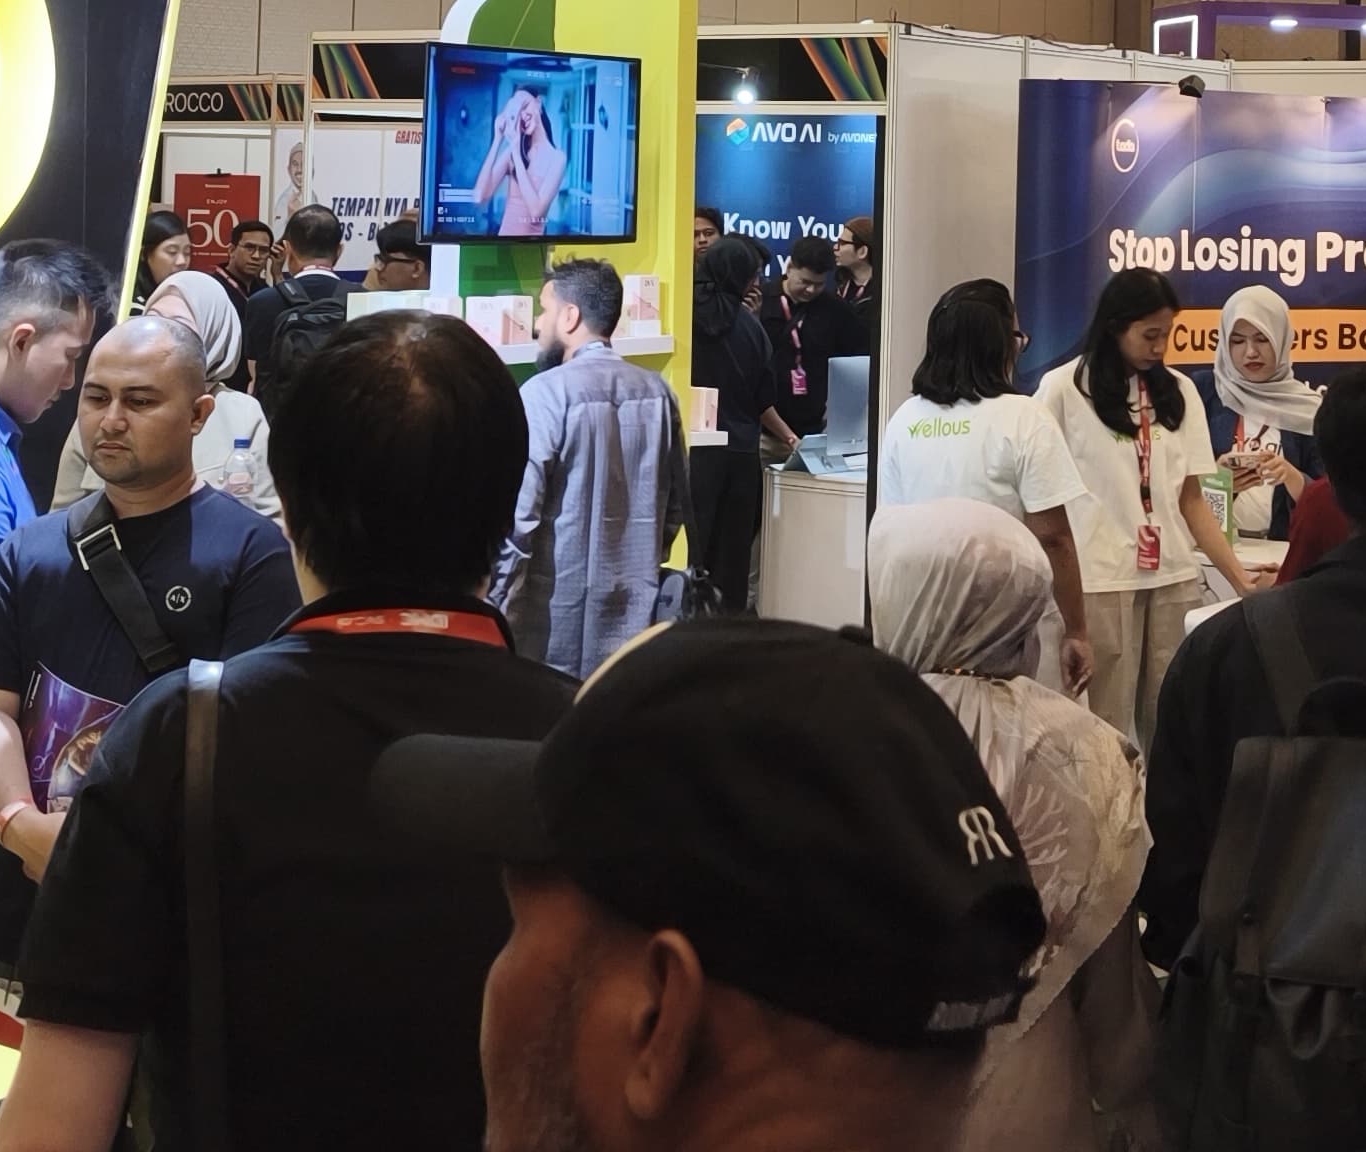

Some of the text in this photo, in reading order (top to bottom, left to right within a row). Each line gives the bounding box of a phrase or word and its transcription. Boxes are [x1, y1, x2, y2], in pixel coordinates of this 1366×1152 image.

[751, 122, 877, 145] AVO AI by AVONE
[332, 197, 381, 217] TEMPAT
[187, 209, 240, 248] 50
[723, 212, 792, 240] Know
[1108, 228, 1175, 273] Stop
[1180, 225, 1306, 287] Losing
[1172, 323, 1328, 352] Cusers
